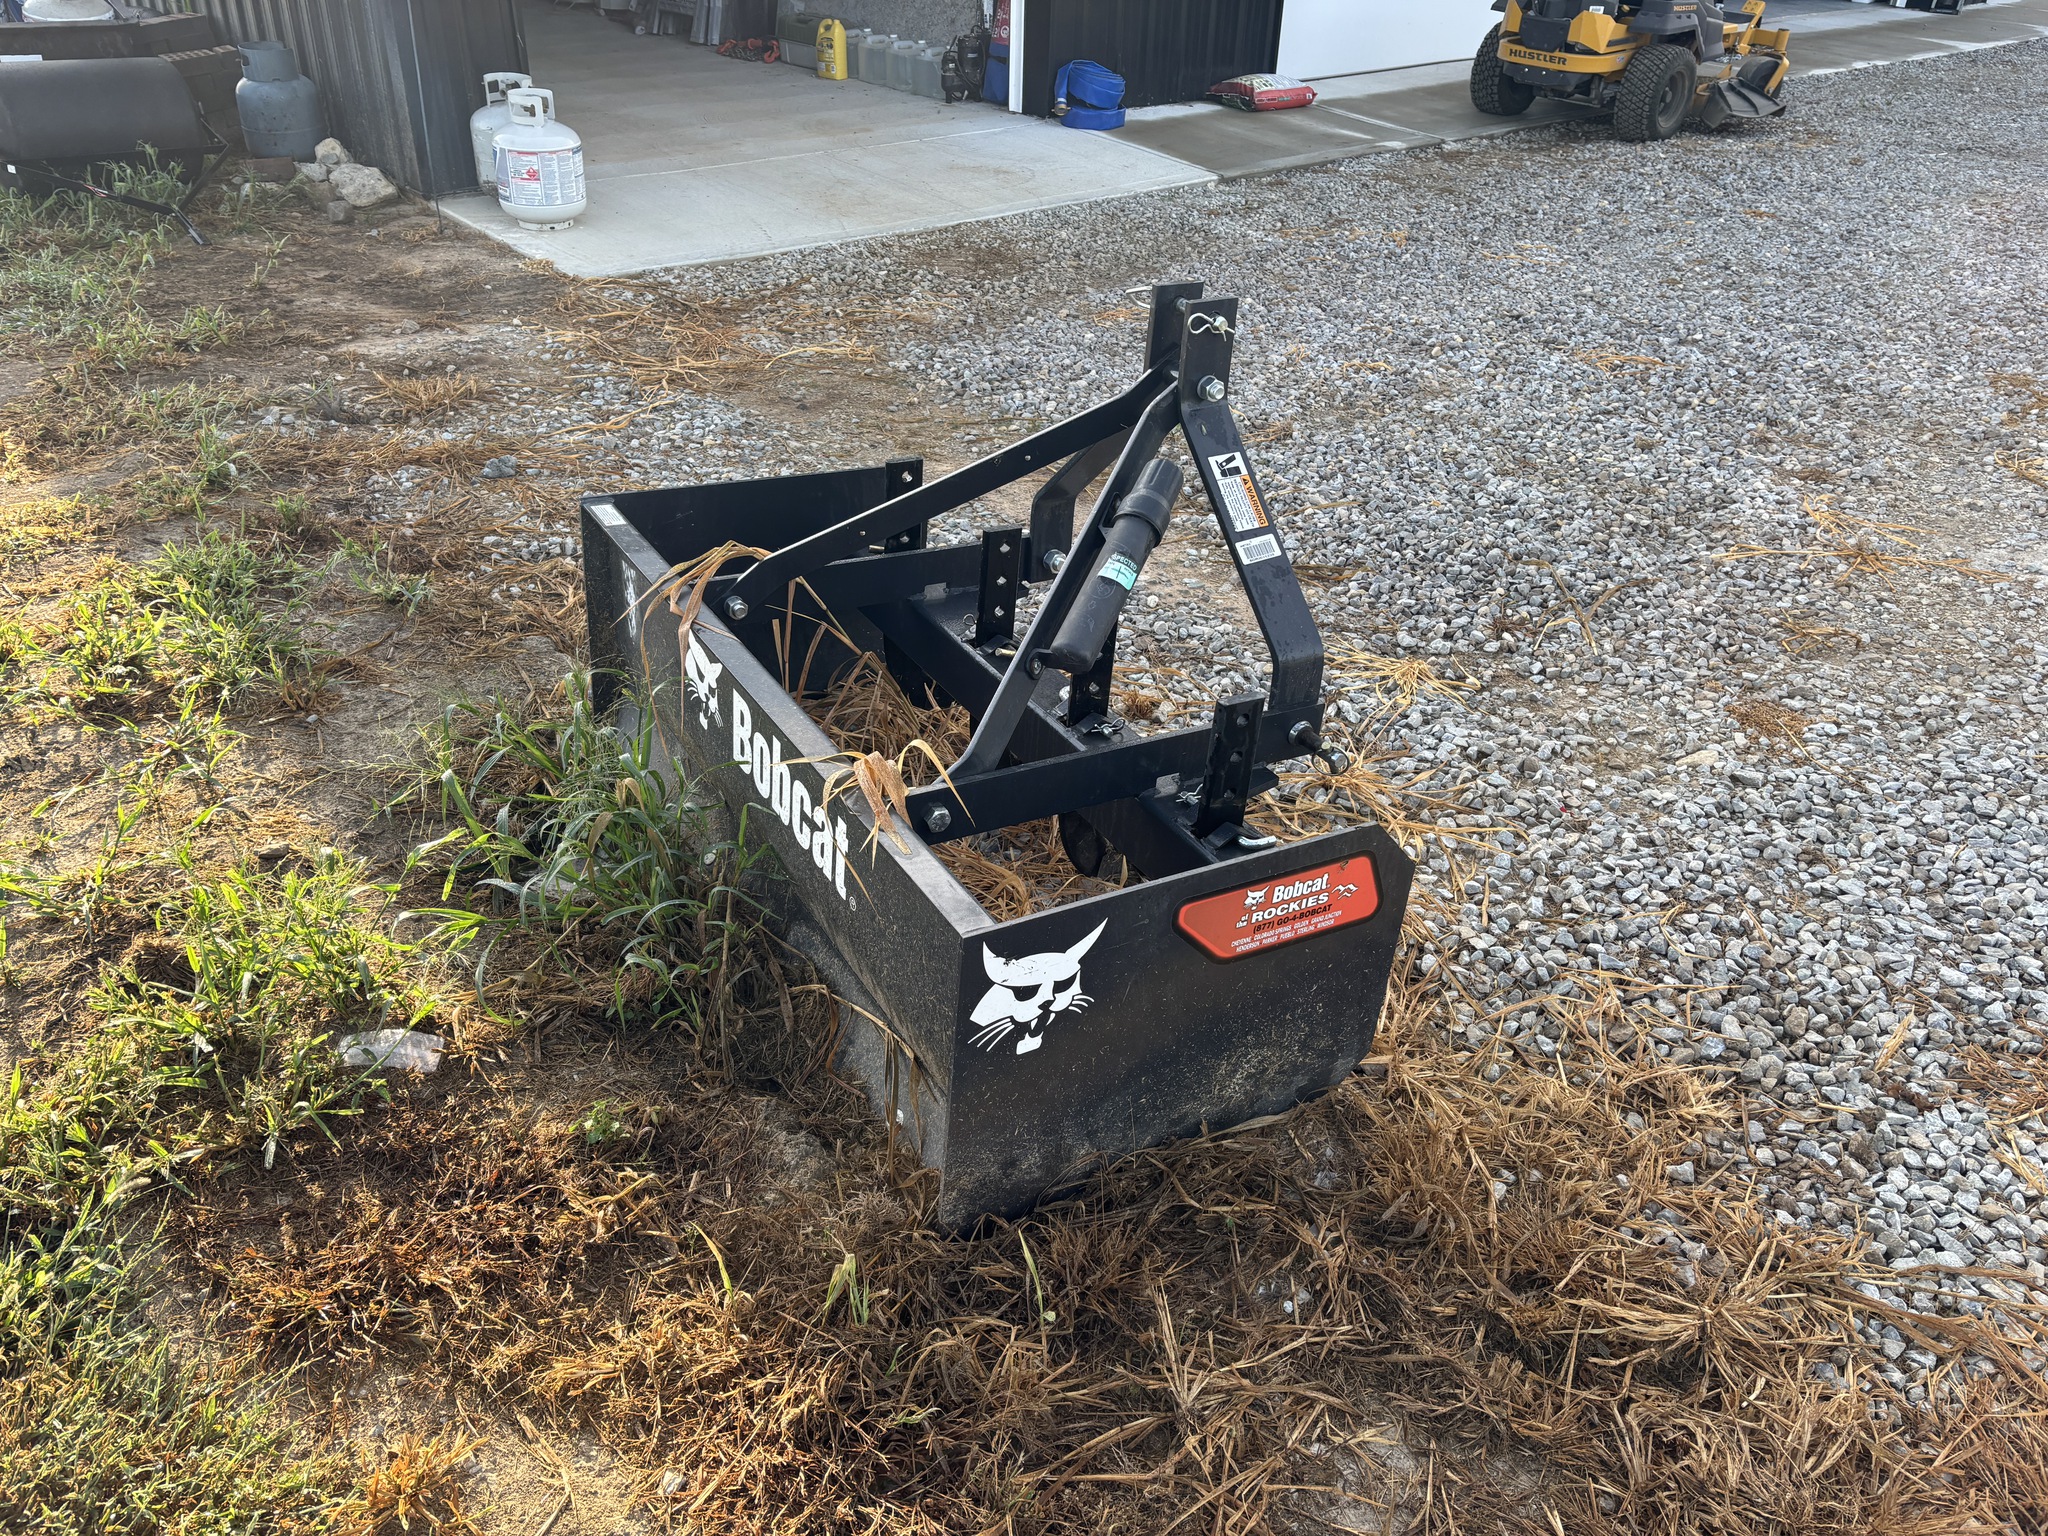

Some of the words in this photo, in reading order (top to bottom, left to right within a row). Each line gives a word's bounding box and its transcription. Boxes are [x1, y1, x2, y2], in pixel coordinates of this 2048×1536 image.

[1508, 48, 1567, 66] HUSTLER
[1246, 486, 1266, 525] WARNING
[1111, 553, 1138, 571] SPECTED
[732, 689, 849, 901] Bobcat
[1272, 873, 1329, 904] Bobcat
[1241, 913, 1249, 921] of
[1251, 892, 1330, 924] ROCKIES
[1253, 920, 1275, 934] (877)
[1277, 904, 1333, 926] GO-4-BOBCAT
[1236, 920, 1248, 928] the
